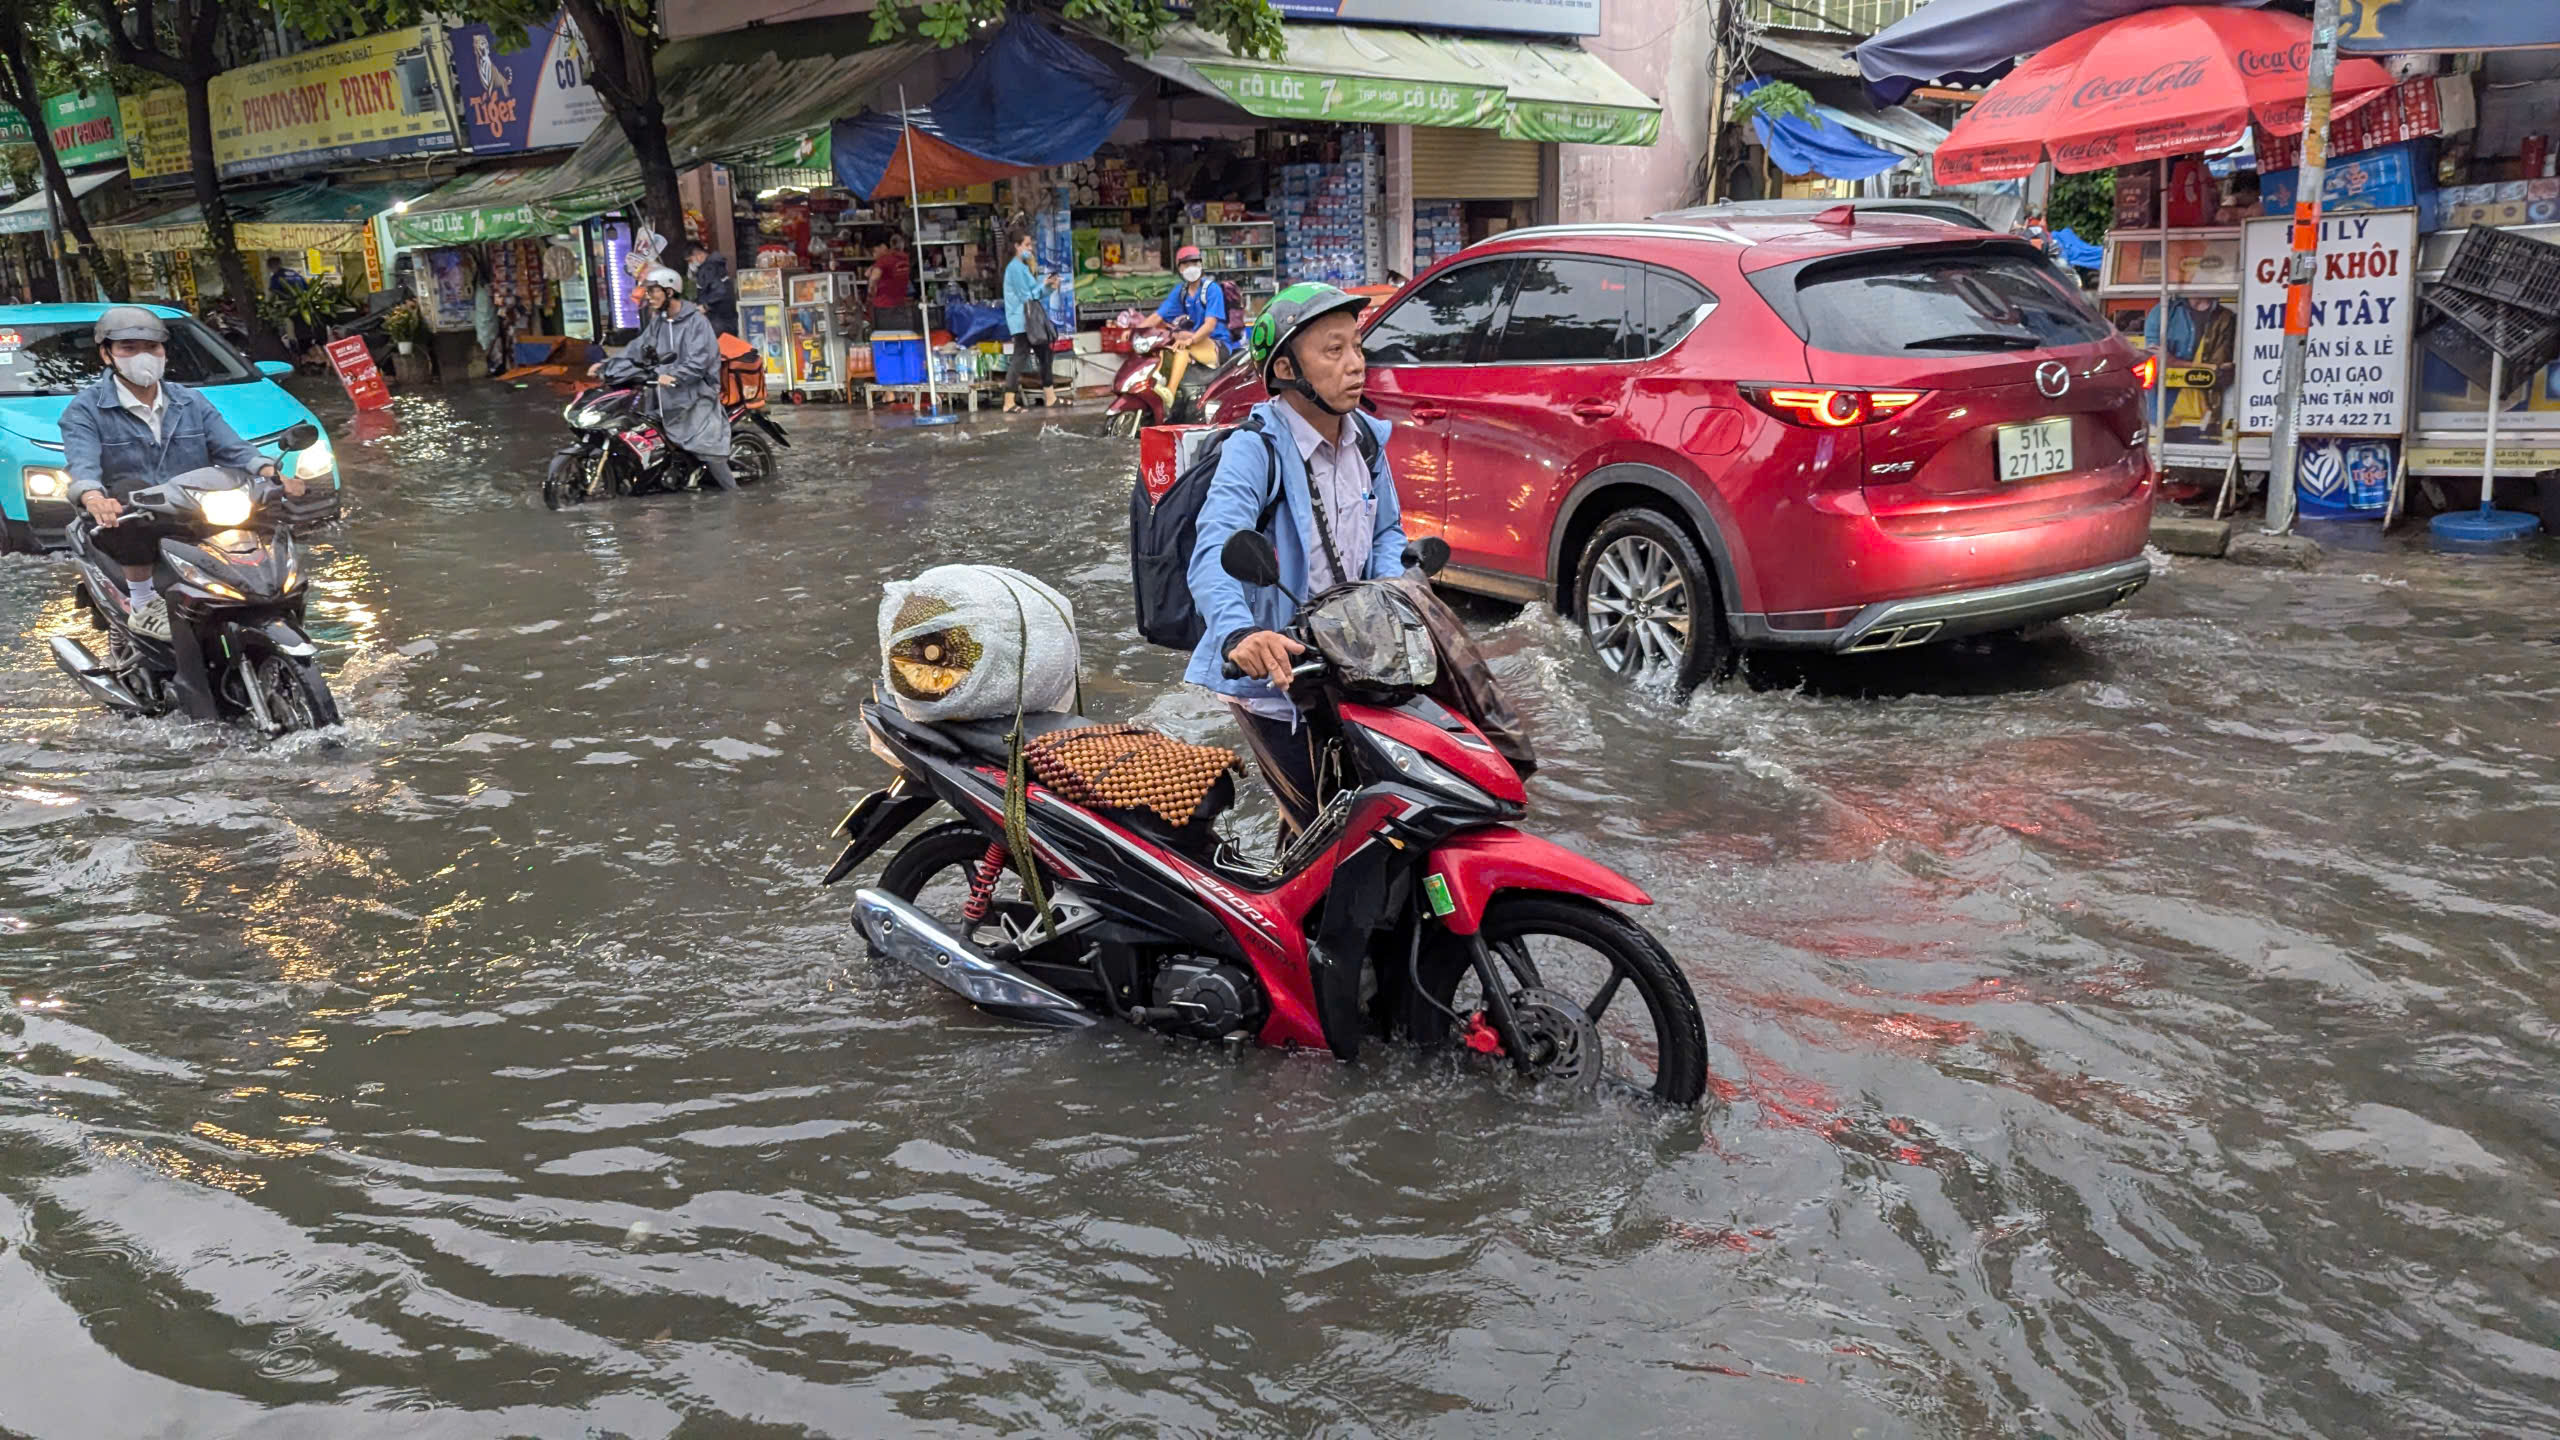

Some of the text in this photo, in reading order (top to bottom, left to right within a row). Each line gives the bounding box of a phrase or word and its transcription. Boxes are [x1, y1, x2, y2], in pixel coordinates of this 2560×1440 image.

[1239, 73, 1264, 97] CÔ
[1270, 76, 1304, 104] LỘC
[1403, 85, 1425, 108] CÔ
[2072, 55, 2214, 109] Coca-Cola
[243, 81, 331, 134] PHOTOCOPY
[340, 69, 395, 117] PRINT
[470, 90, 517, 138] Tiger
[1970, 82, 2064, 122] Coca-Cola
[77, 115, 114, 146] PHONG
[2057, 133, 2120, 163] Coca-Cola
[2338, 213, 2369, 241] LÝ
[2256, 241, 2399, 289] GẠ KHÔI
[2334, 289, 2396, 326] TÂY
[2306, 338, 2330, 358] ÁN
[2335, 336, 2350, 357] SỈ
[2354, 340, 2368, 356] &
[2374, 334, 2393, 356] LẺ
[2346, 365, 2383, 387] GẠO
[2333, 389, 2363, 407] TẬN
[2368, 389, 2394, 405] NƠI
[2250, 415, 2273, 427] ĐT:
[2306, 413, 2334, 426] 374
[2339, 413, 2368, 426] 422
[2373, 413, 2392, 426] 71
[2020, 426, 2051, 450] 51K
[2009, 449, 2065, 477] 271.32
[2352, 466, 2387, 487] Tiger
[1199, 875, 1278, 929] SPORT
